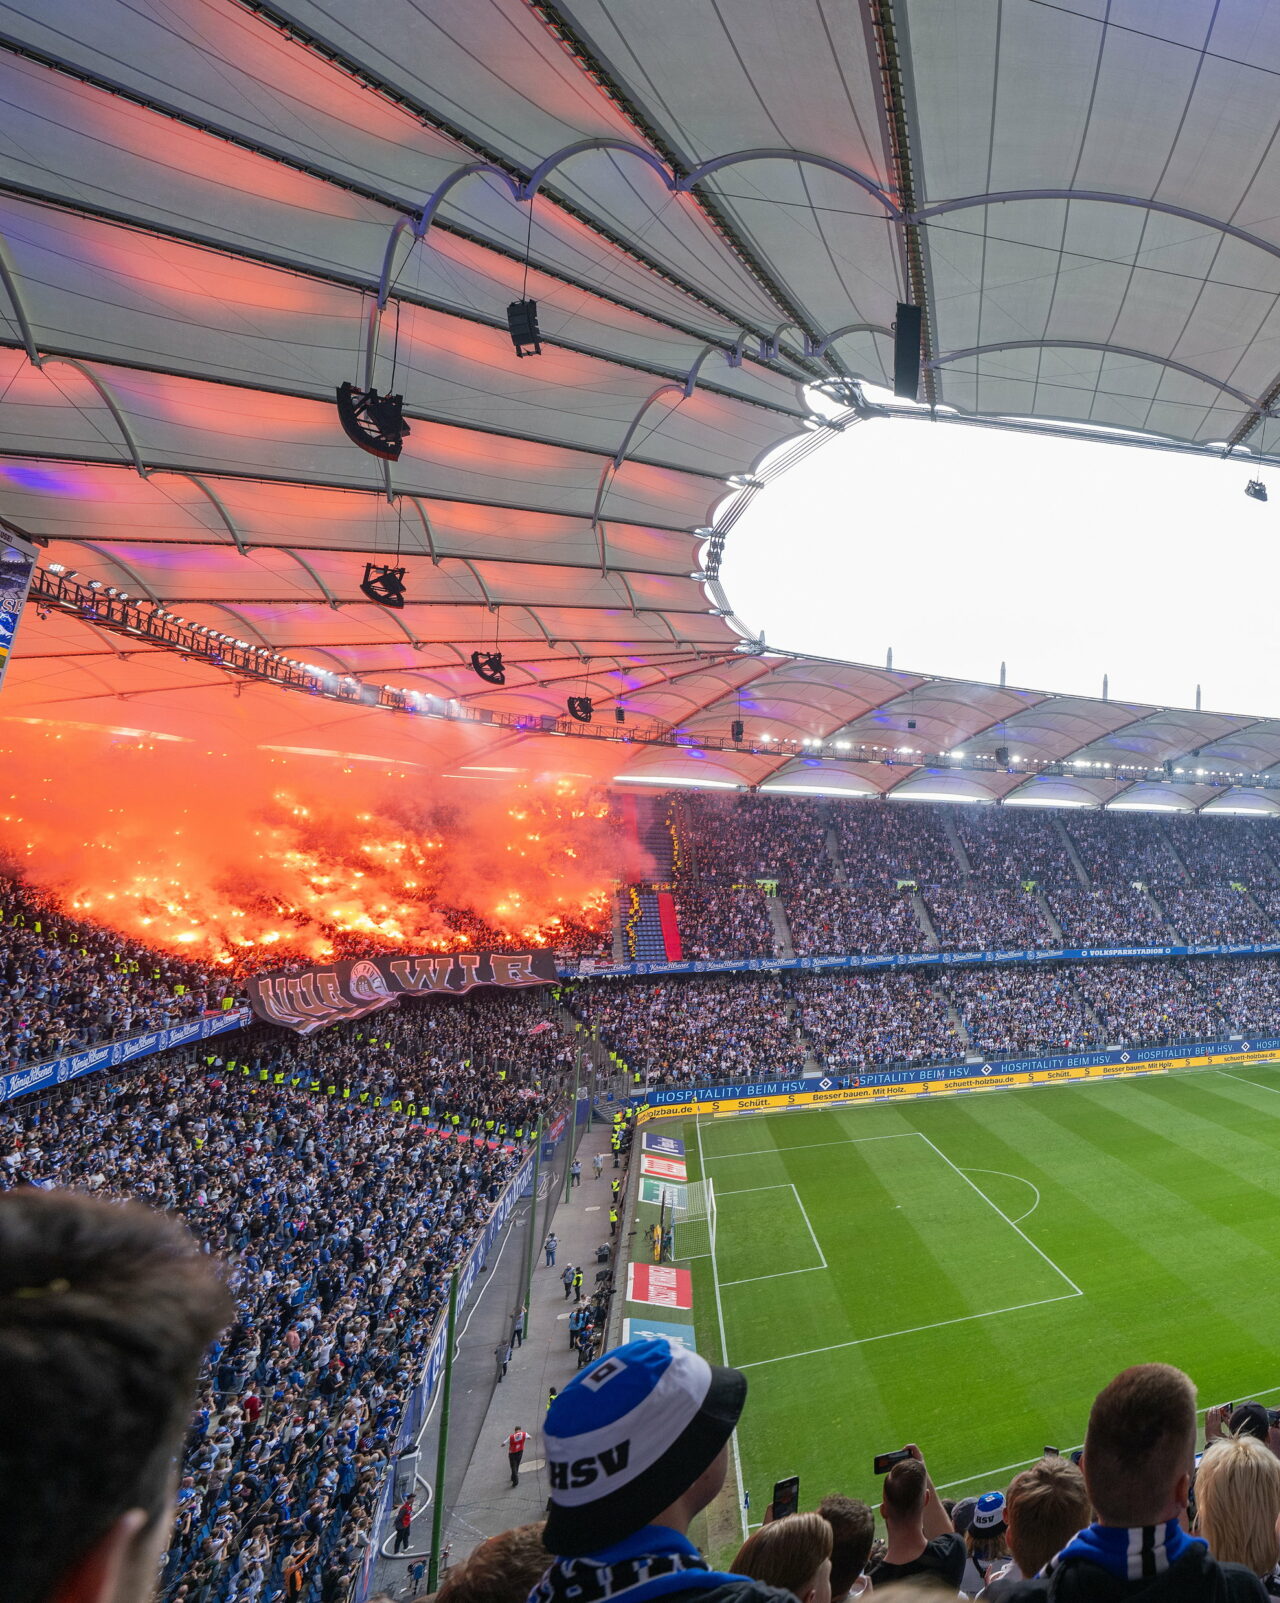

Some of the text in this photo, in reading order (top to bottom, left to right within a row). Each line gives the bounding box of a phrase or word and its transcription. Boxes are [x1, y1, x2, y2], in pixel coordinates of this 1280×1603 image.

[1090, 948, 1163, 956] VOLKSPARKSTADION
[259, 954, 547, 1024] NUR WIR
[1138, 1048, 1191, 1060] HOSPITALITY
[1218, 1044, 1234, 1052] HSV.
[1224, 1052, 1276, 1062] schuett-holzbau.de
[1001, 1053, 1112, 1072] HOSPITALITY BEIM HSV.
[1104, 1066, 1125, 1074] Besser
[1148, 1062, 1158, 1070] Mit
[920, 1069, 944, 1080] BEIM
[950, 1067, 972, 1077] HSV.
[1048, 1070, 1072, 1078] Schütt.
[944, 1076, 1014, 1088] schuett-holzbau.de
[656, 1081, 808, 1103] HOSPITALITY BEIM HSV.
[813, 1086, 906, 1101] Besser bauen. Mit Holz.
[738, 1098, 770, 1108] Schütt.
[550, 1439, 630, 1490] HSV
[976, 1515, 994, 1524] HSV
